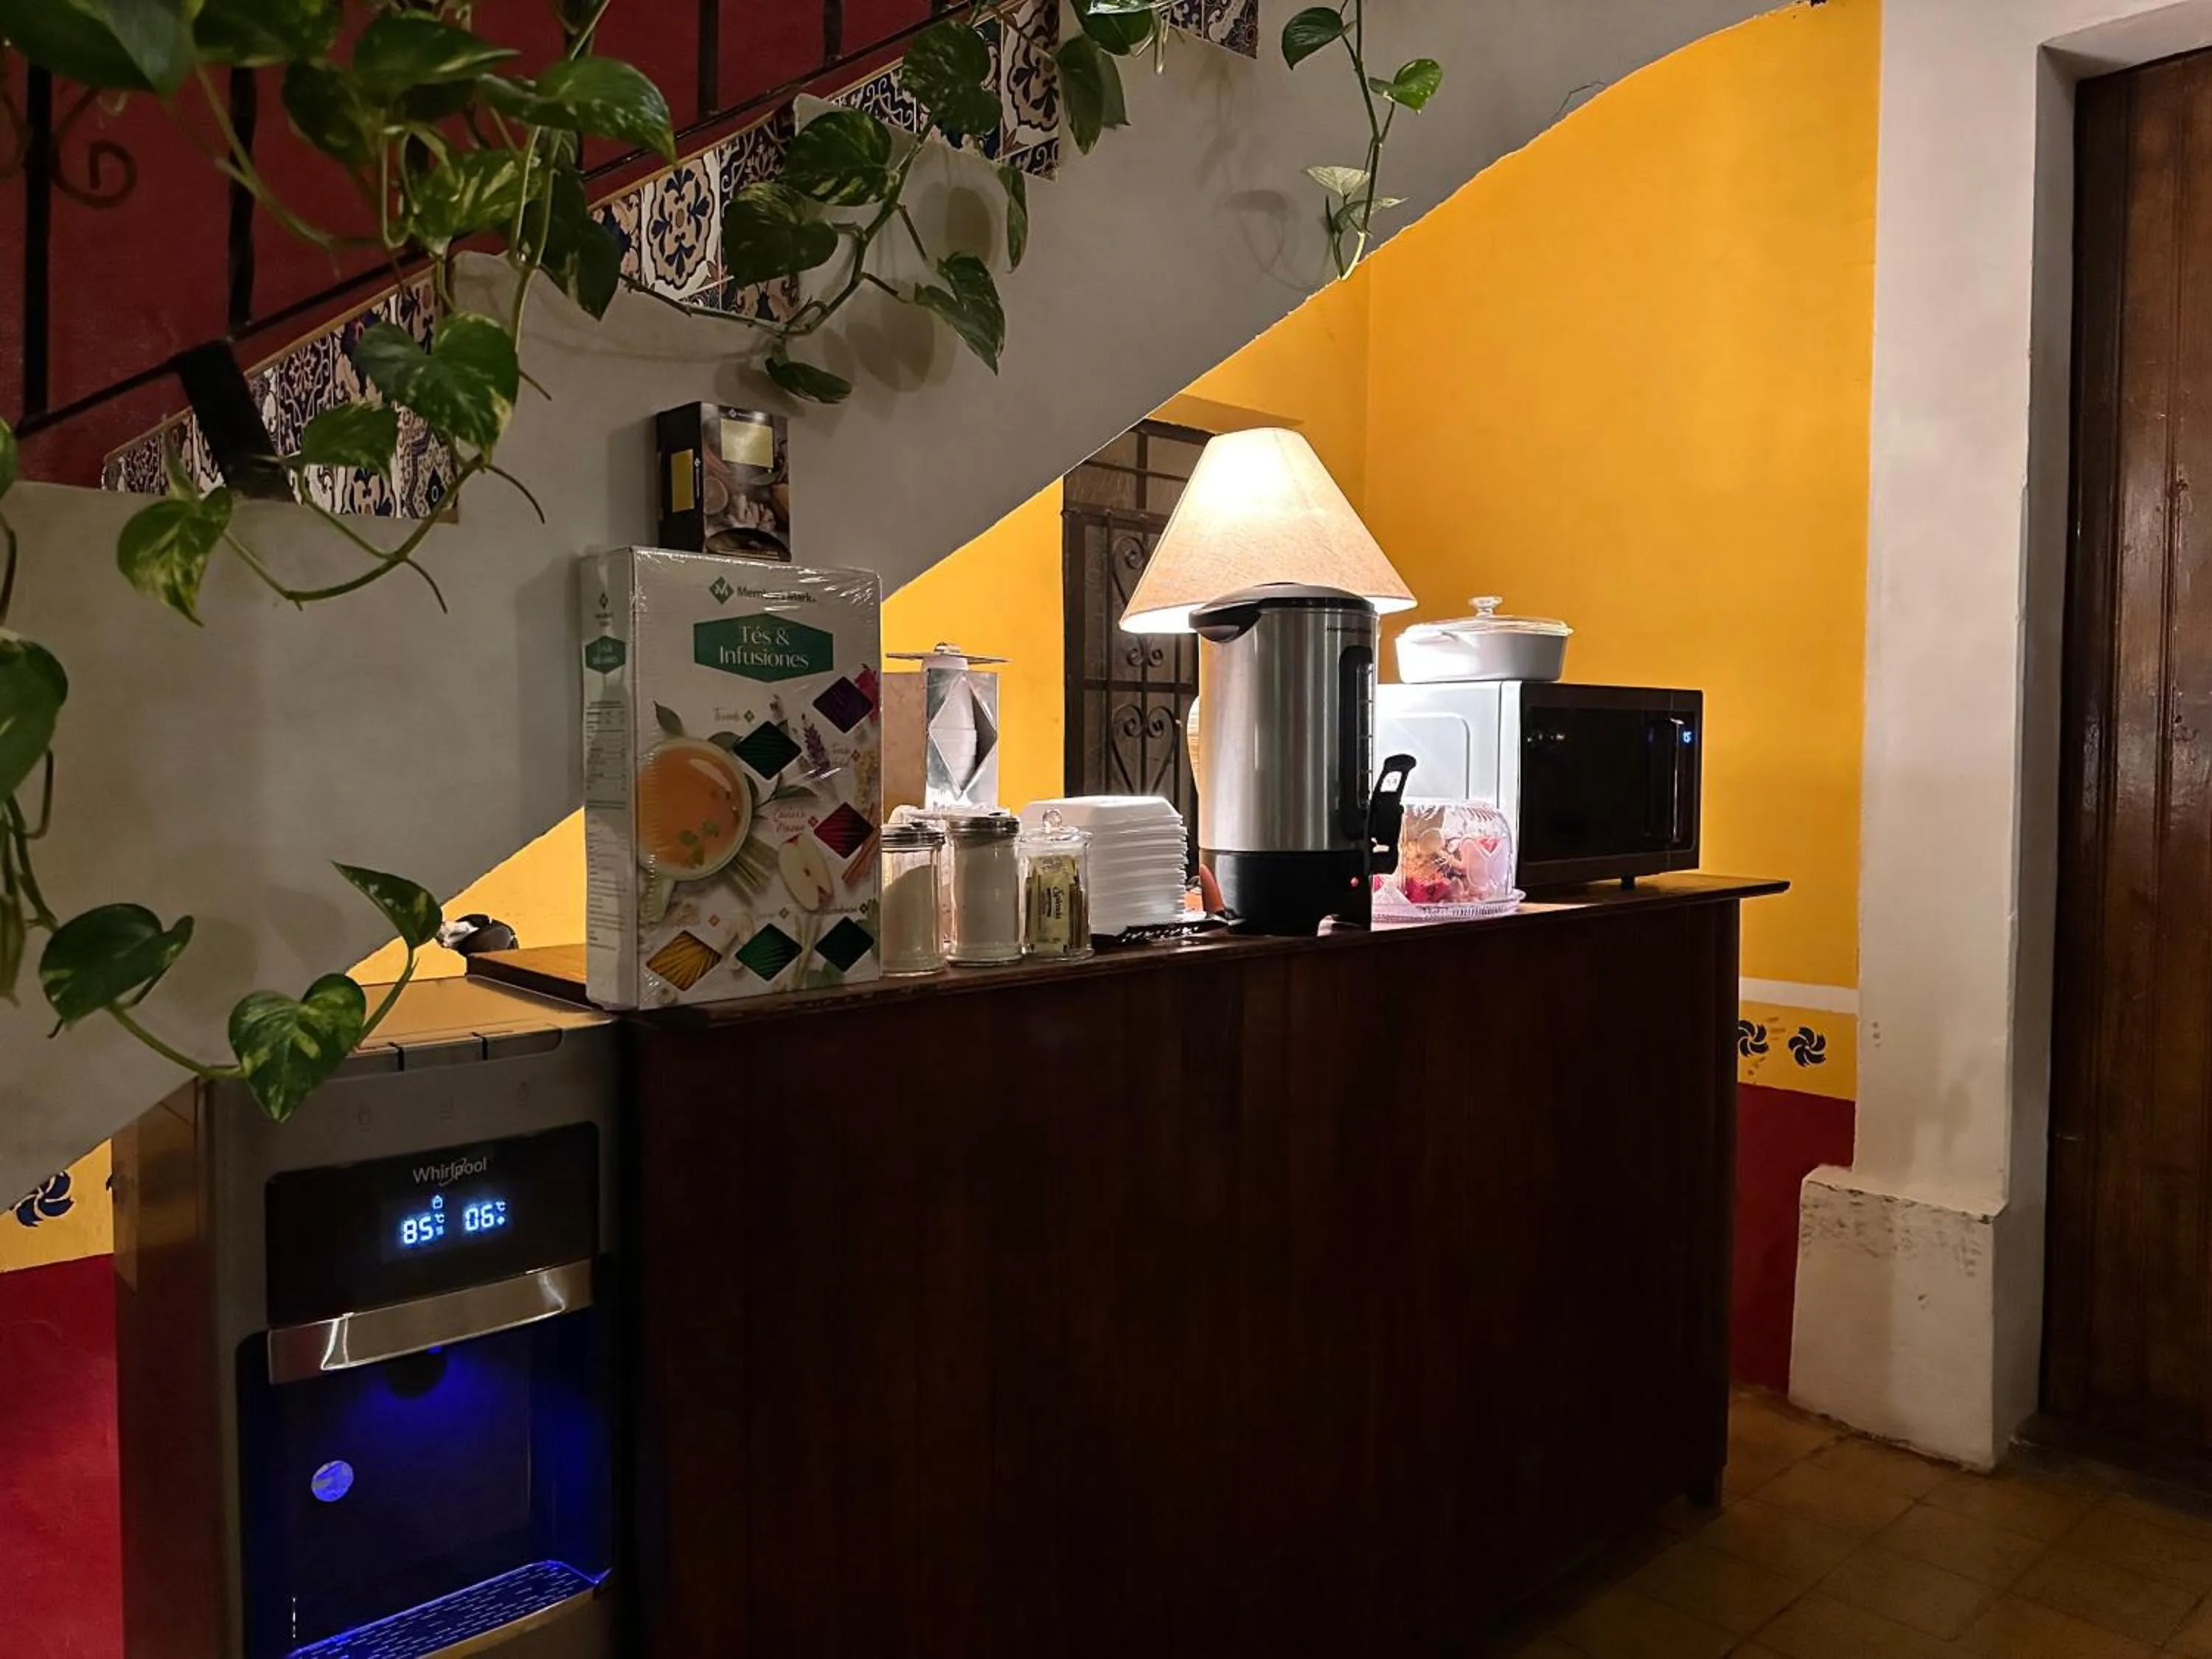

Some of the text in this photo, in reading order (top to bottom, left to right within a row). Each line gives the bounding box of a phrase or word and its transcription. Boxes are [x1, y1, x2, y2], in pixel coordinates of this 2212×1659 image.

[740, 625, 790, 646] Tés &
[720, 644, 810, 669] Infusiones
[412, 1156, 487, 1185] Whirlpool
